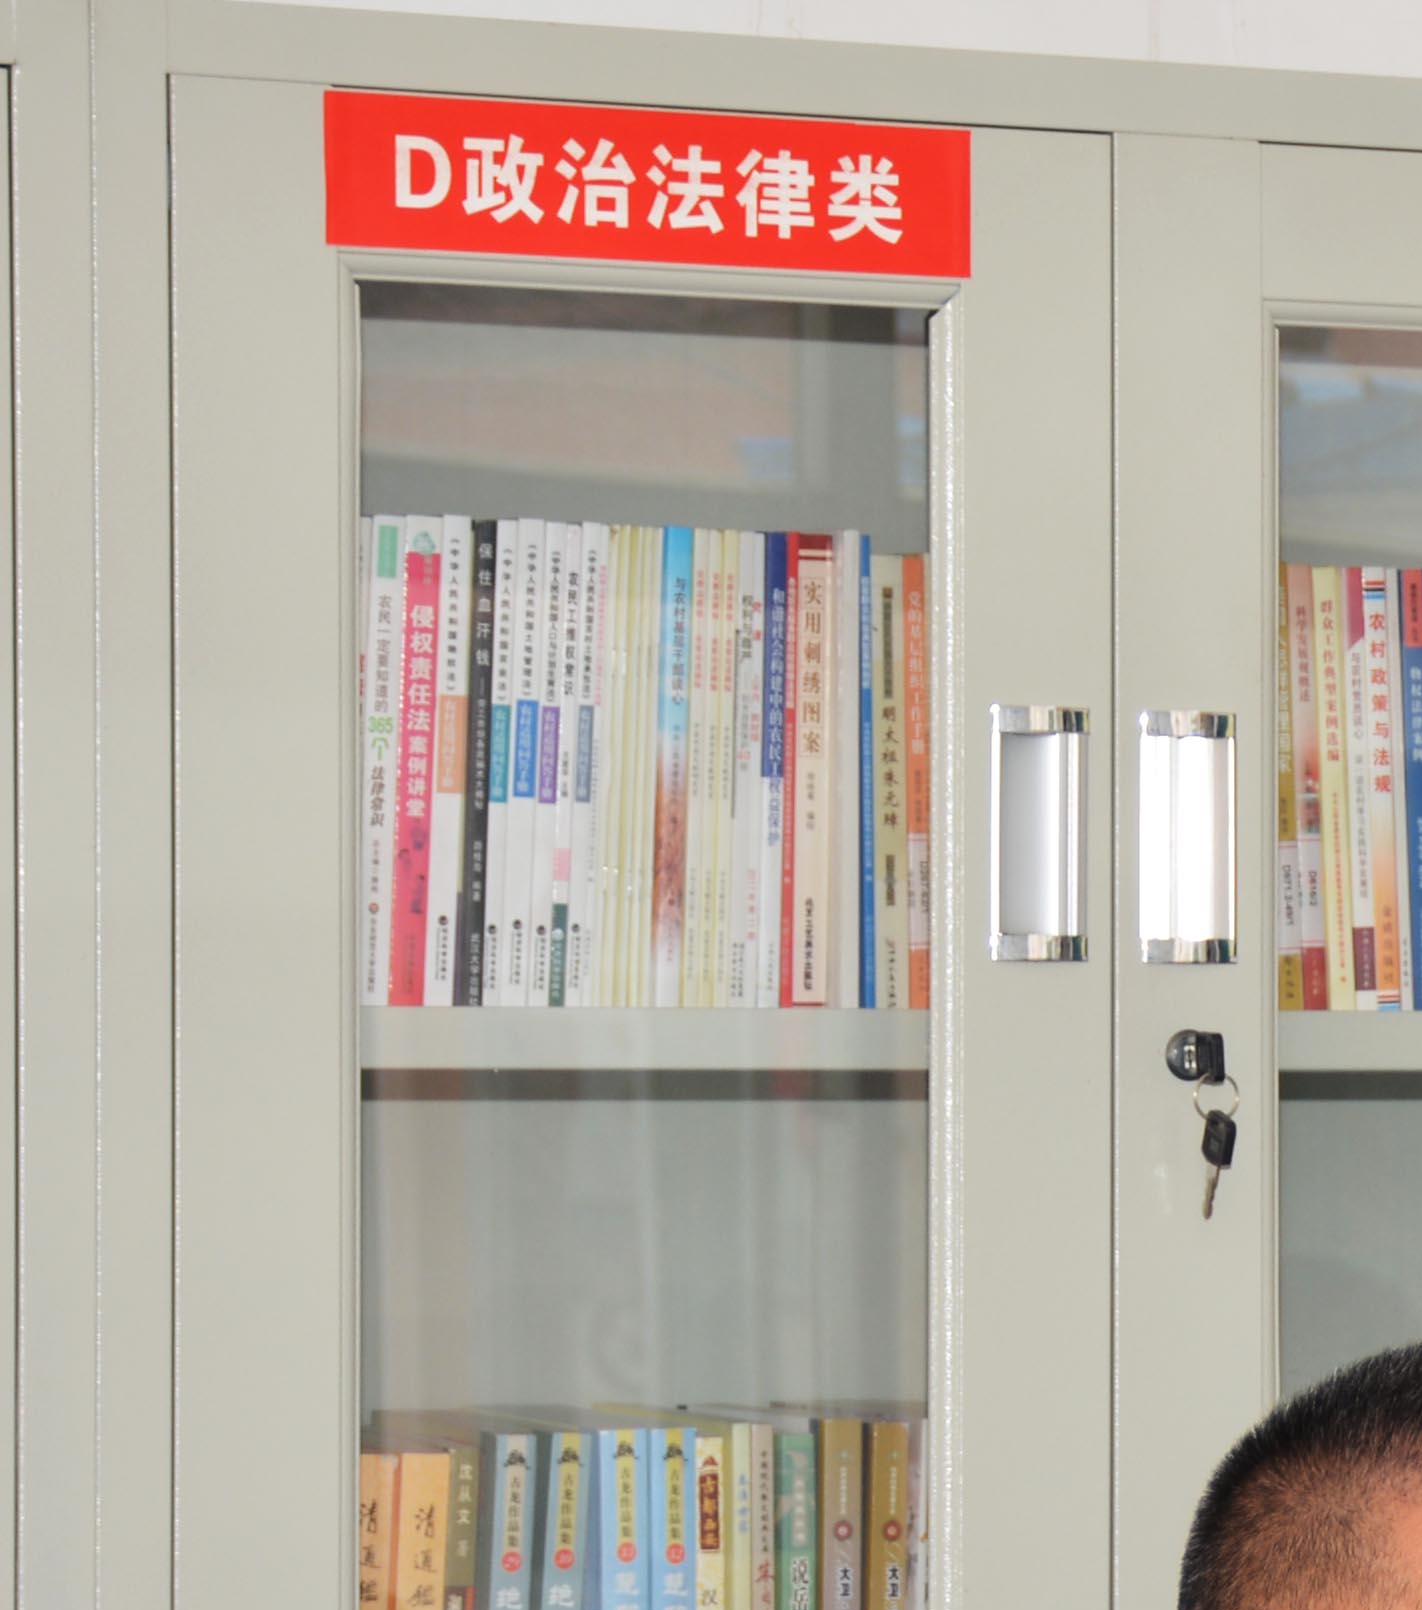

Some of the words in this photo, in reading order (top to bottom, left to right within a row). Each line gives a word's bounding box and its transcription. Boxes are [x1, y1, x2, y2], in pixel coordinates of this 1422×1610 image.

[394, 133, 903, 243] D政治法律类
[474, 543, 493, 666] 保住血汗钱
[802, 581, 823, 754] 实用刺绣图案
[406, 605, 435, 817] 侵权责任法案例讲堂
[882, 705, 899, 829] 明太祖朱元璋
[1369, 613, 1392, 792] 农村政策与法规
